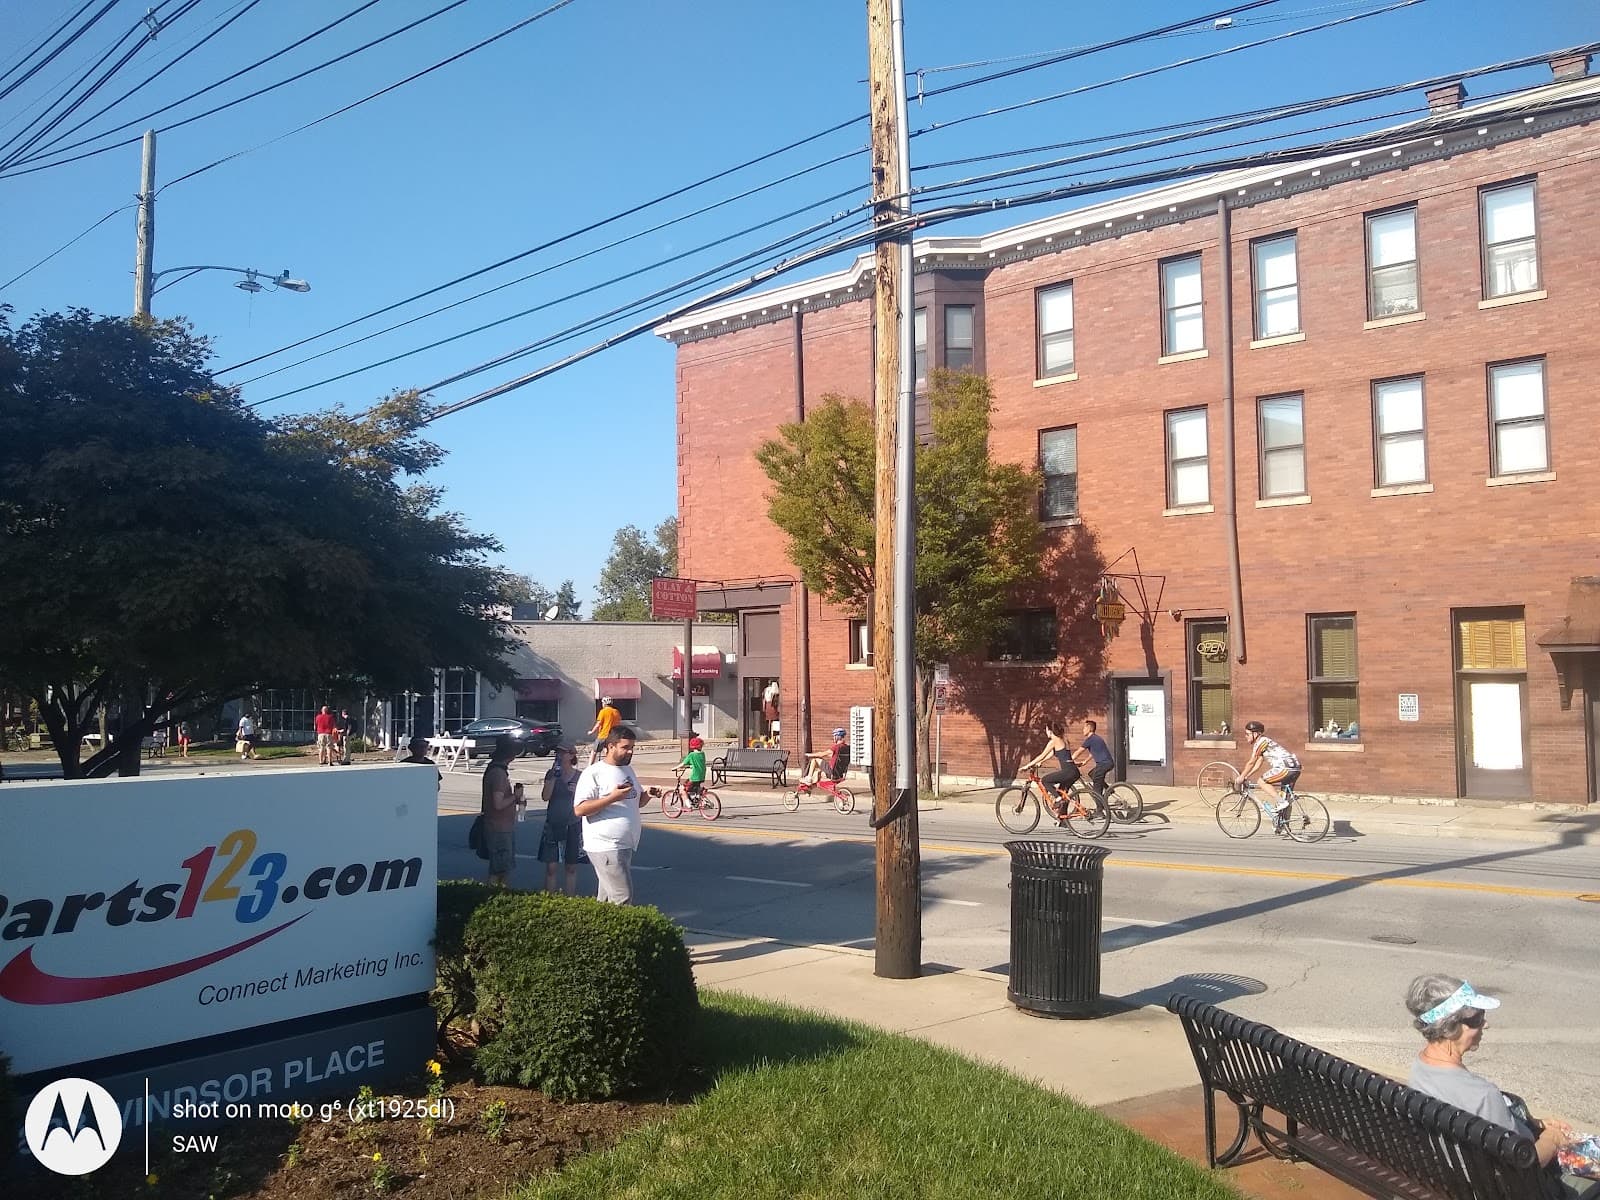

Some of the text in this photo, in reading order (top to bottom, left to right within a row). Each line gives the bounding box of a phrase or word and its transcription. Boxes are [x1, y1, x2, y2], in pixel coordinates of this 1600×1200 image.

[656, 591, 693, 602] COTTON
[1197, 643, 1226, 653] OPEN
[198, 950, 425, 1006] Connect Marketing Inc.
[283, 1039, 386, 1089] PLACE
